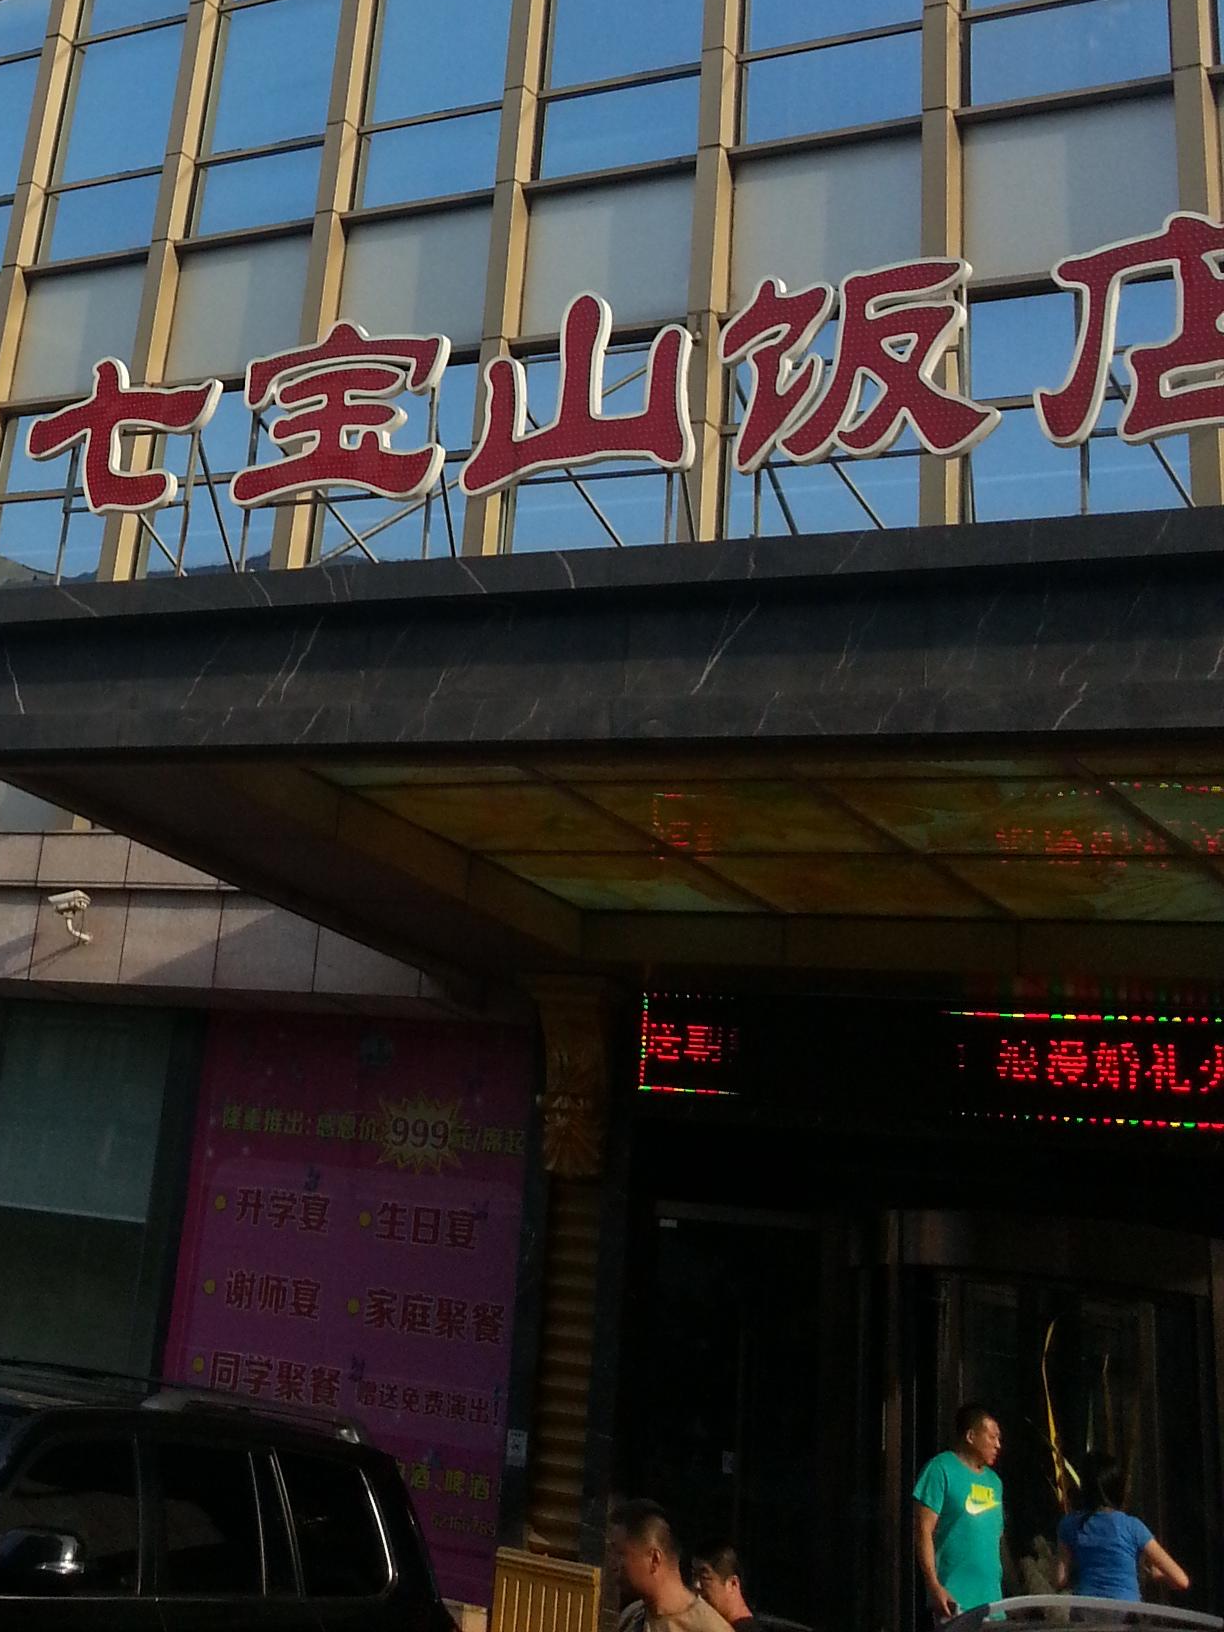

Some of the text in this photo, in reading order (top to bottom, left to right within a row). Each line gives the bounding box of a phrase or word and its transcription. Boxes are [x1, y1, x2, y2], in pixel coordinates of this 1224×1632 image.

[390, 1117, 450, 1151] 999
[234, 1186, 331, 1236] 升学宴
[375, 1202, 479, 1252] 生日宴
[224, 1269, 322, 1321] 谢师宴
[363, 1288, 505, 1346] 家庭聚餐
[209, 1351, 342, 1409] 同学聚餐
